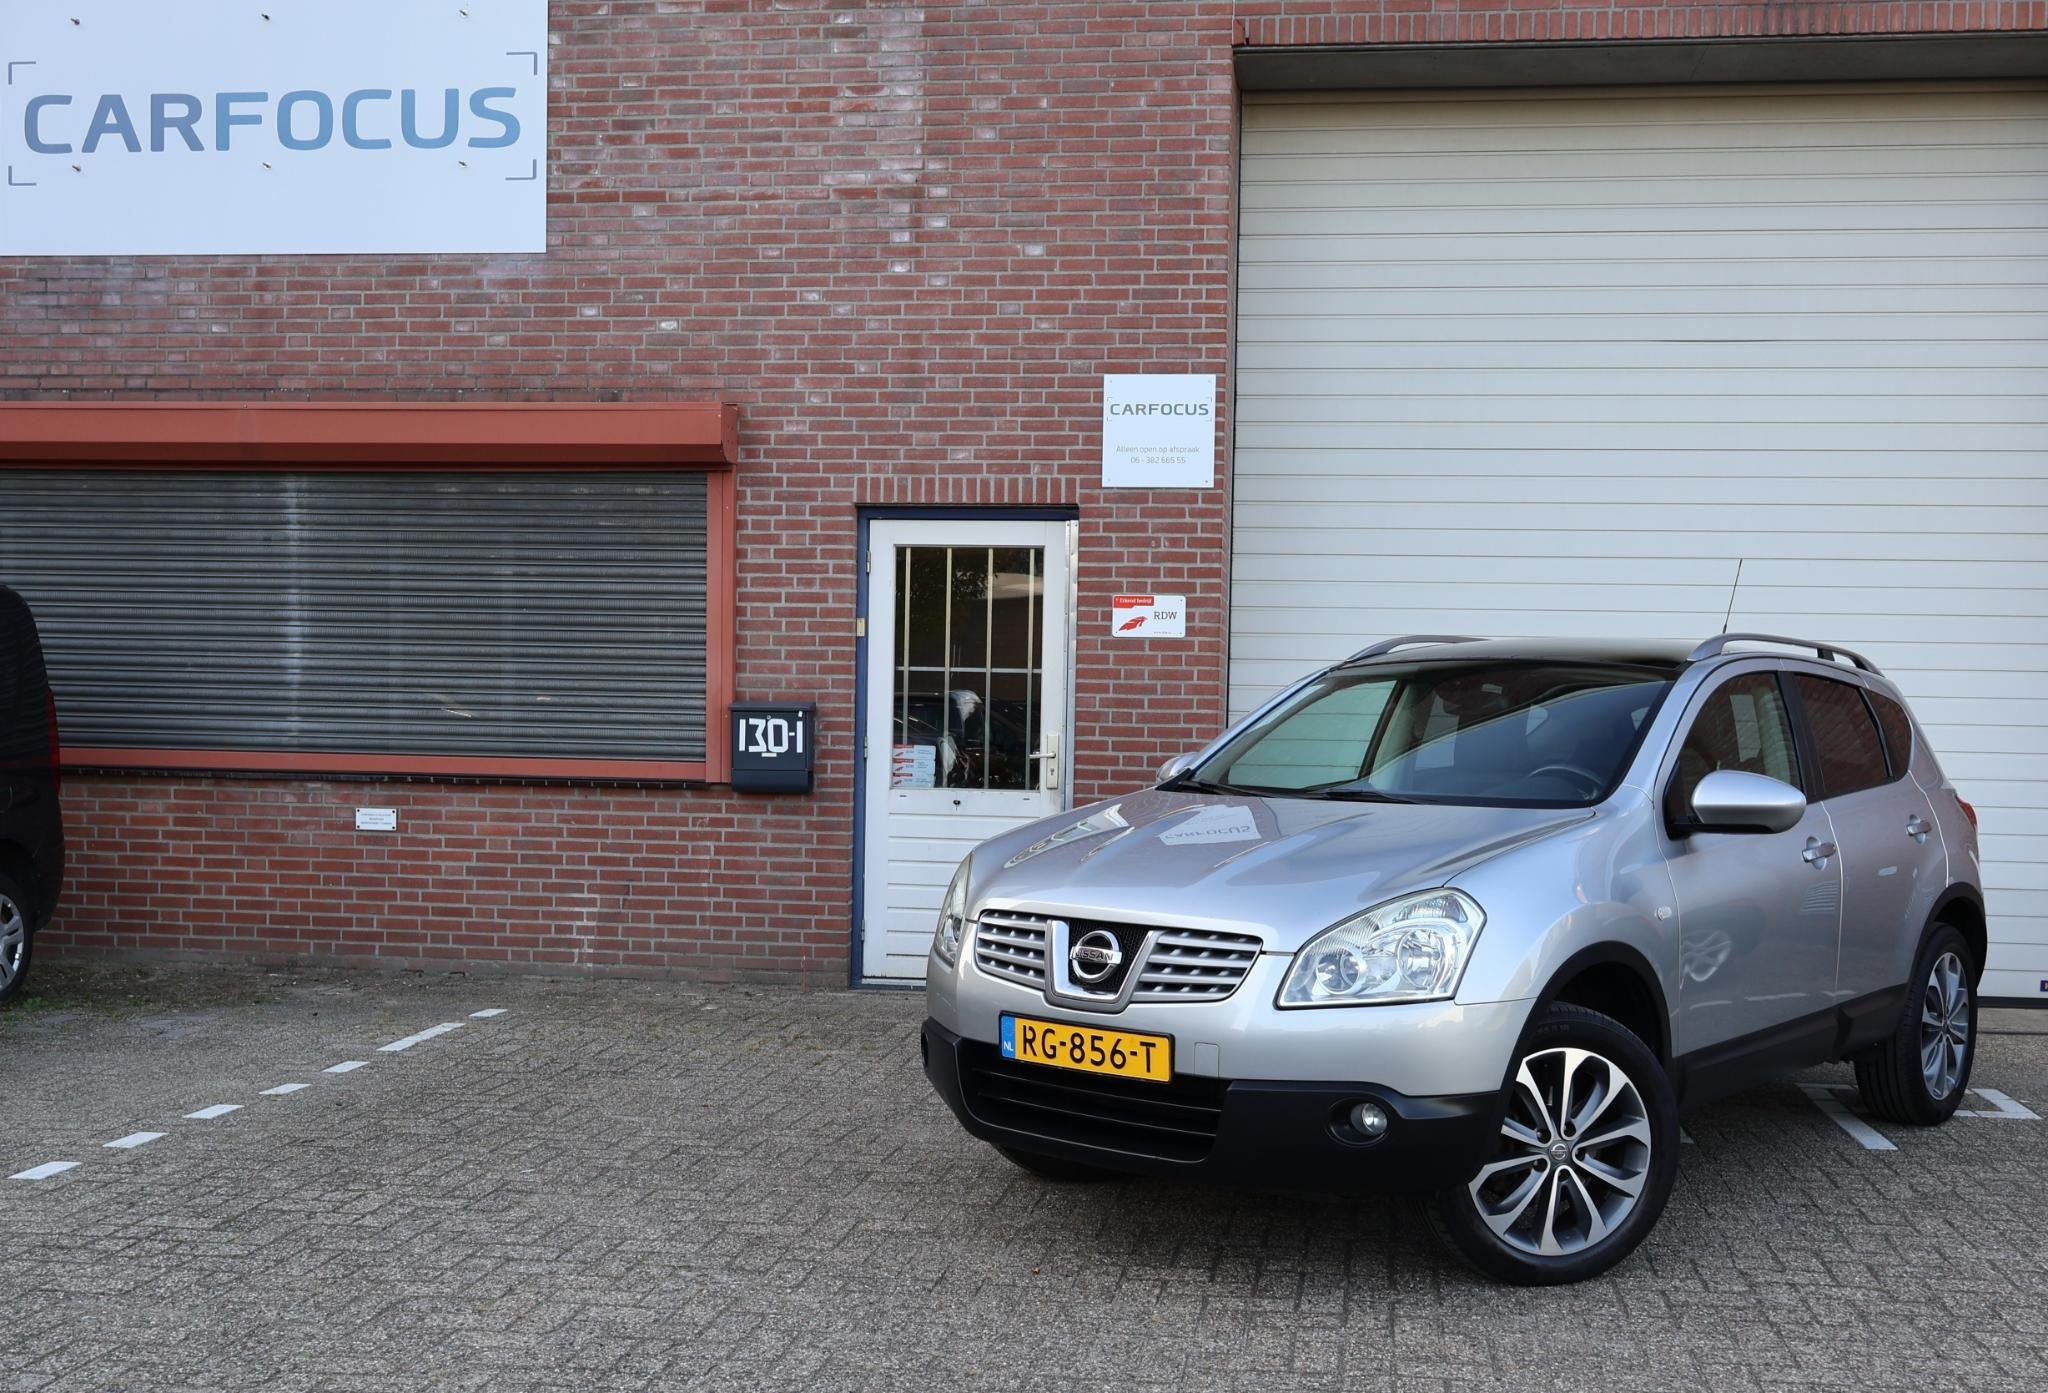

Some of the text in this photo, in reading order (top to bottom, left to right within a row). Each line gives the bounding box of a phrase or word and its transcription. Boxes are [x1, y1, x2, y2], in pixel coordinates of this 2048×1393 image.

[24, 87, 520, 154] CARFOCUS
[1110, 403, 1209, 416] CARFOCUS
[1116, 445, 1138, 453] Alleen
[1170, 445, 1199, 454] afspraak
[1153, 611, 1178, 620] RDW
[1003, 1041, 1014, 1052] NL
[1022, 1025, 1157, 1073] RG-856-T
